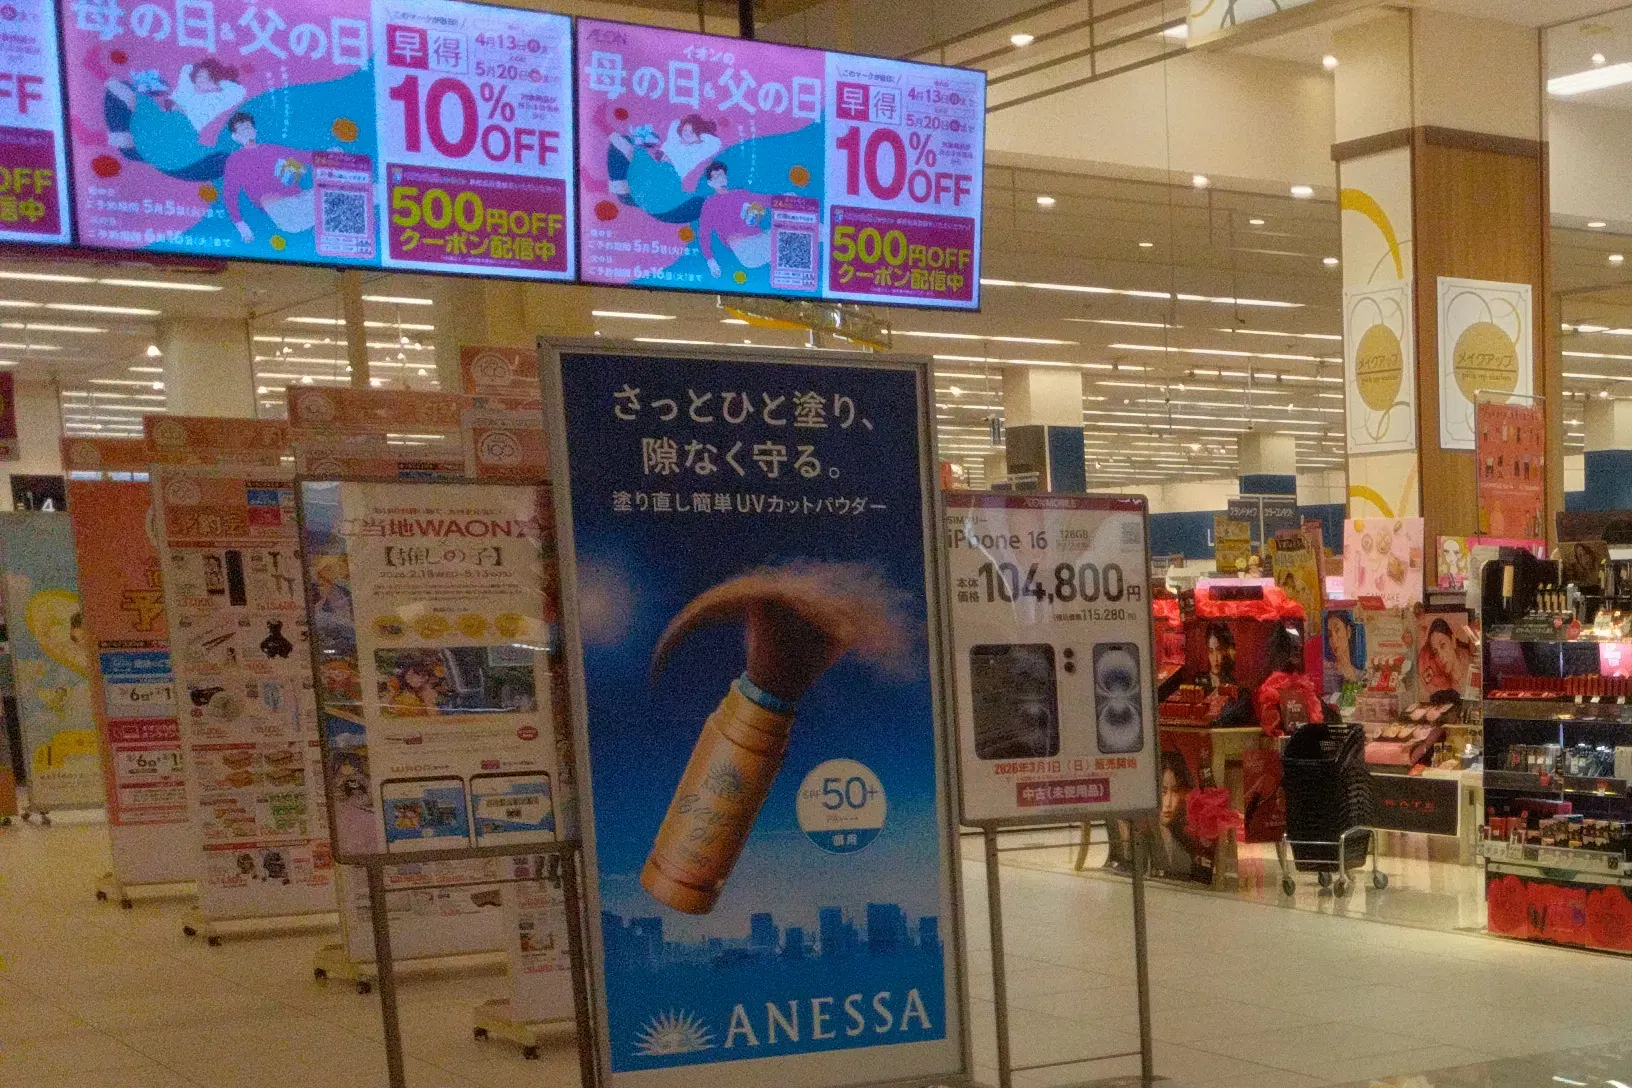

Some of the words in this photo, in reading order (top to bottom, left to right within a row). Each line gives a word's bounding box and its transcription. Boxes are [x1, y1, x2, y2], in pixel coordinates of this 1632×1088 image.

[683, 45, 735, 65] イオンの
[584, 50, 823, 124] 母の日&父の日
[481, 123, 560, 166] OFF
[907, 170, 973, 206] OFF
[392, 186, 563, 237] 500円OFF
[401, 229, 556, 262] クーポン配信中
[833, 226, 971, 268] 500円OFF
[839, 263, 965, 292] クーポン配信中
[1458, 352, 1513, 368] メイクアップ
[613, 383, 874, 431] さっとひと塗り、
[643, 437, 840, 478] 隙なく守る。
[612, 490, 887, 514] 塗り直し簡単UVカットパウダー
[1027, 530, 1049, 550] 16
[822, 777, 878, 811] 50+
[724, 988, 933, 1048] ANESSA
